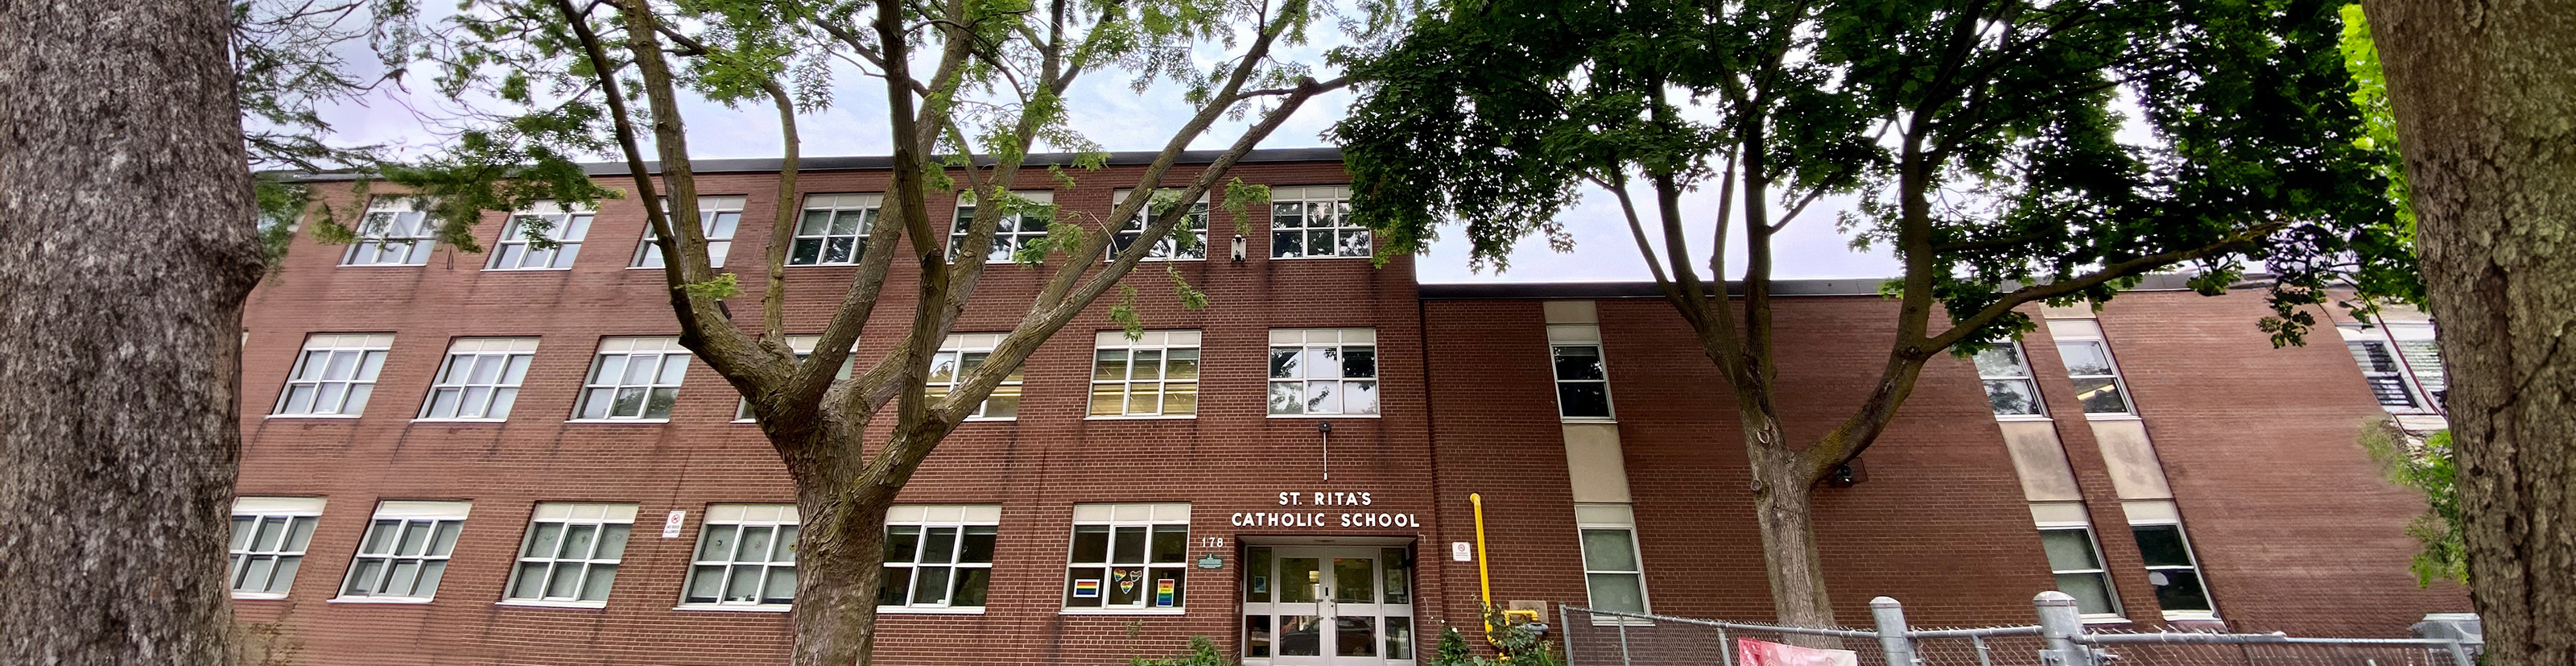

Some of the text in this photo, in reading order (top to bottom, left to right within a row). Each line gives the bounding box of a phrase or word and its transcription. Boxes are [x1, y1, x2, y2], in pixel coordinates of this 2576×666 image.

[1278, 491, 1372, 506] ST. RITA'S
[1231, 512, 1420, 527] CATHOLIC SCHOOL
[1202, 536, 1224, 548] 178
